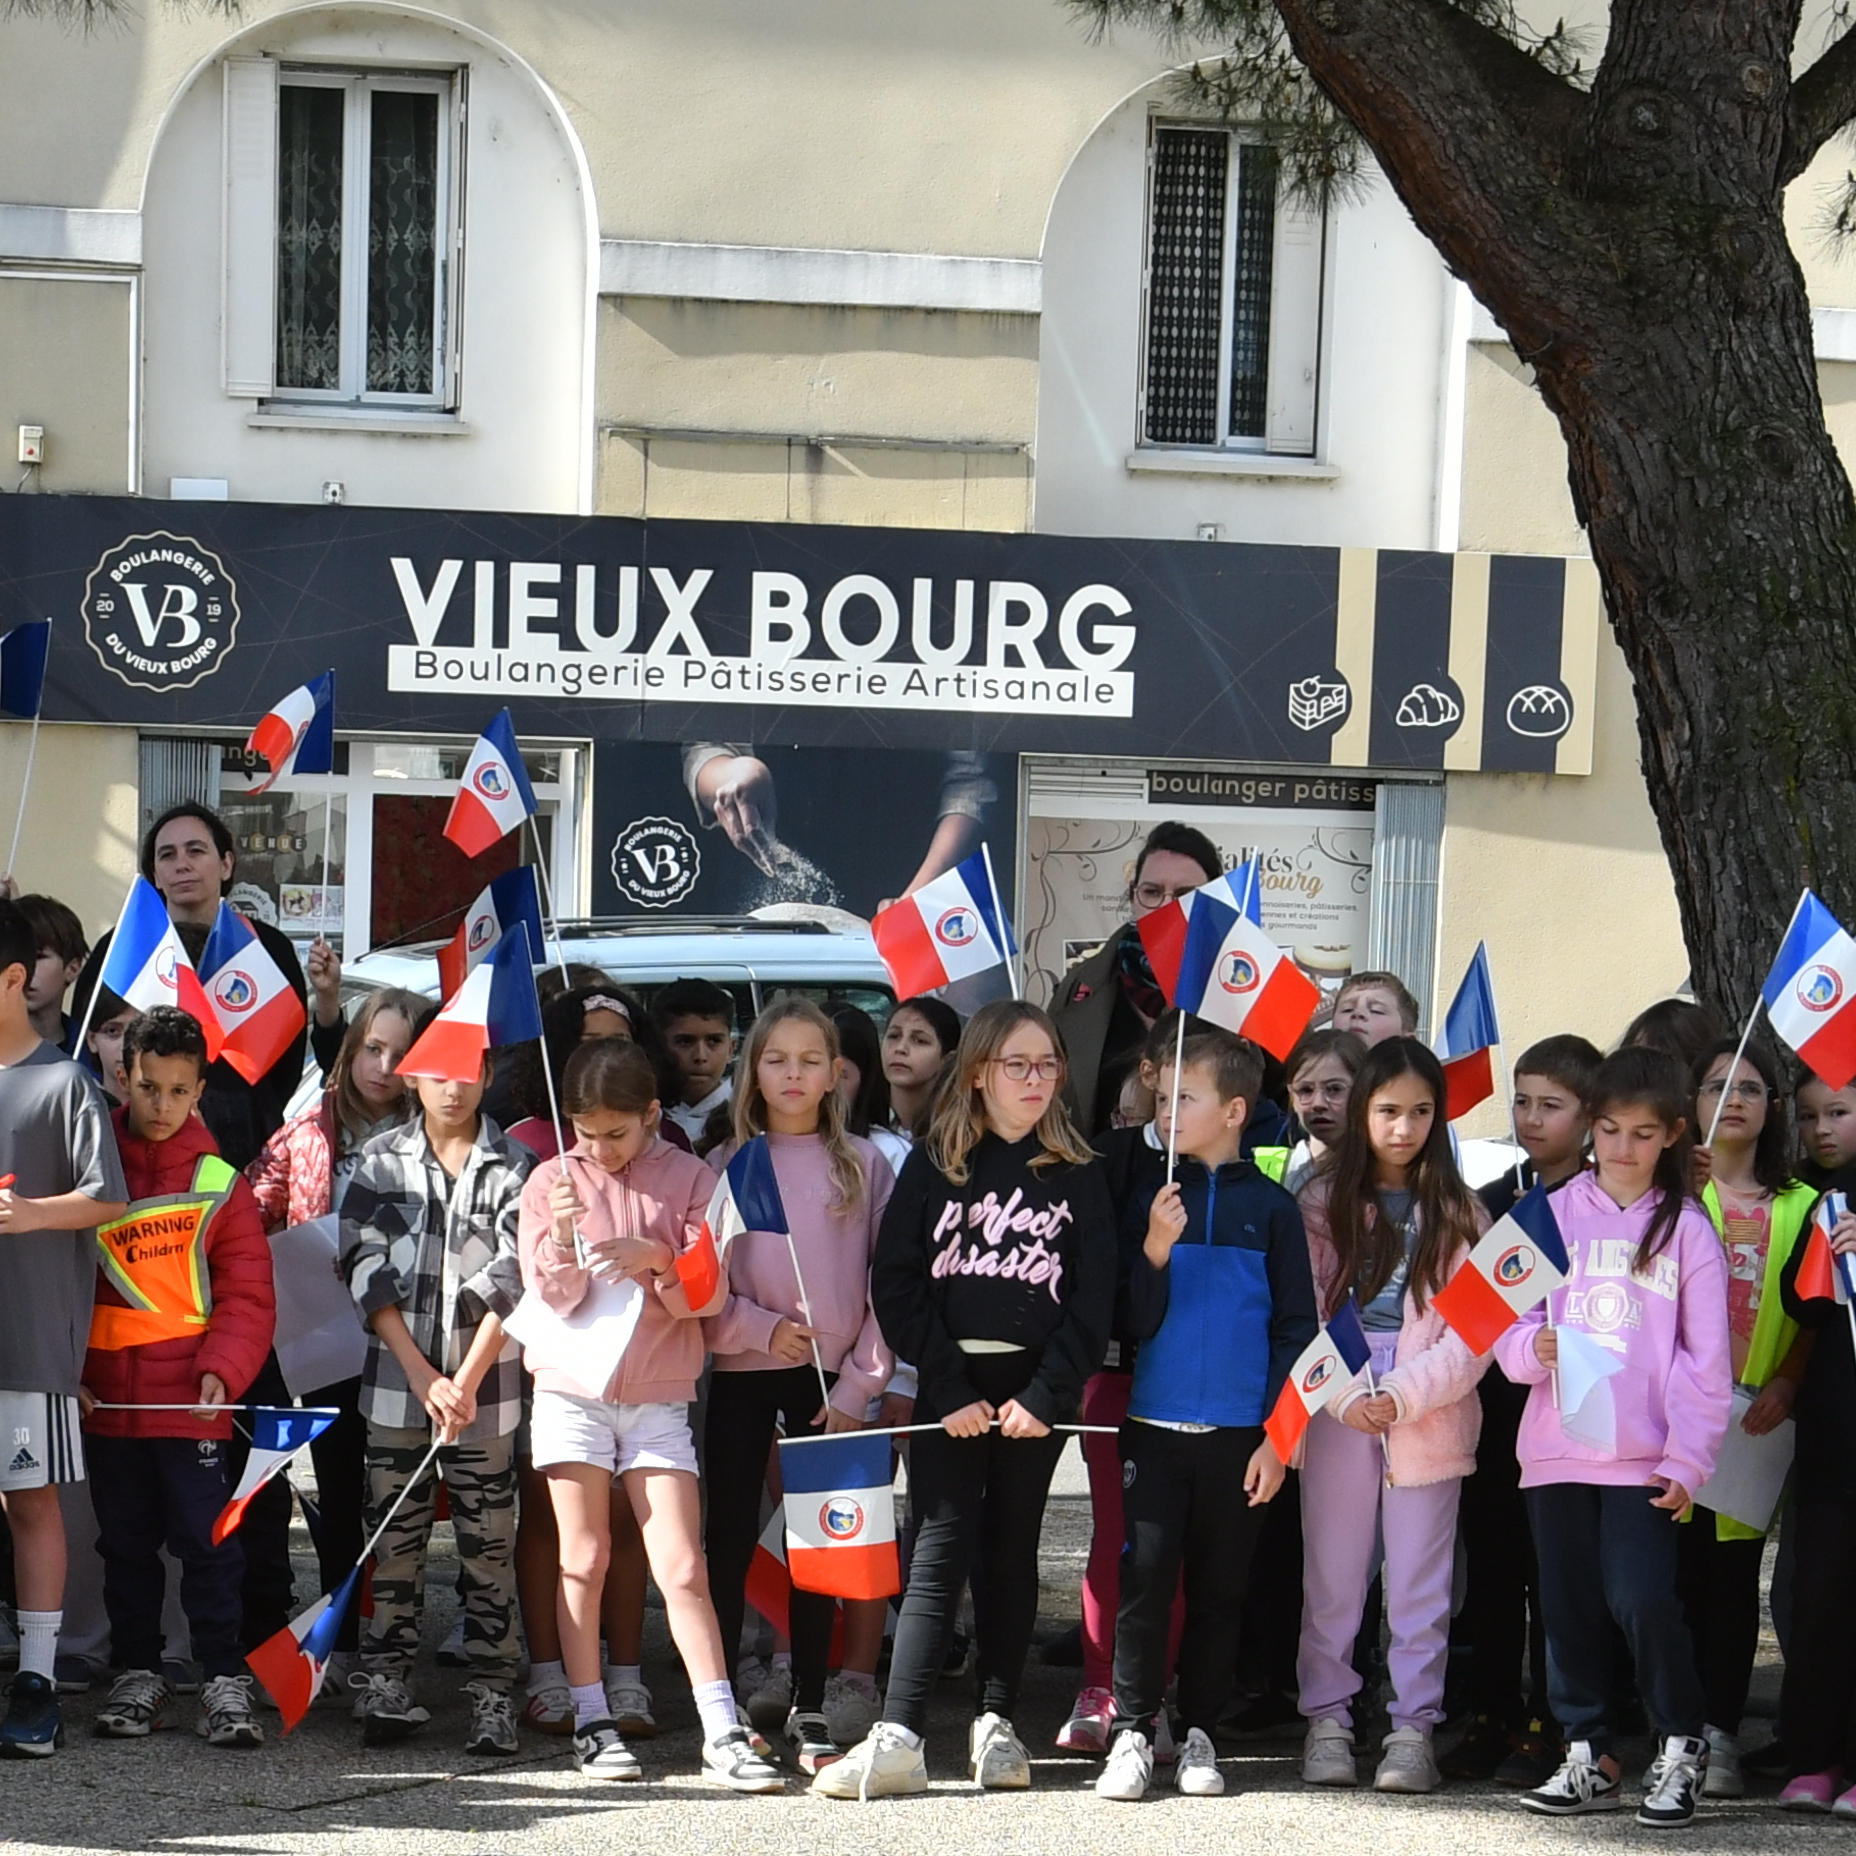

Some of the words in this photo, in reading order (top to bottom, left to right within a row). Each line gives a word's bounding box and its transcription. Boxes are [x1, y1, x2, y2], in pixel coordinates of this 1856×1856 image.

[110, 549, 216, 586] BOULANGERIE
[96, 599, 115, 613] 20
[119, 582, 201, 648] VB
[206, 603, 222, 616] 19
[390, 556, 715, 658] VIEUX
[750, 570, 1138, 673] BOURG
[105, 633, 127, 655] DU
[125, 650, 168, 675] VIEUX
[170, 636, 218, 674] BOURG
[413, 650, 666, 696] Boulangerie
[682, 659, 889, 696] Pâtisserie
[901, 667, 1117, 704] Artisanale
[1151, 771, 1287, 804] boulanger
[1294, 779, 1377, 804] pâtiss
[240, 832, 303, 851] VENUE
[630, 844, 681, 884] VB
[110, 1215, 195, 1247] WARNING
[932, 1186, 1074, 1247] perfect
[125, 1242, 185, 1264] Childrn
[931, 1230, 1064, 1306] disaster
[12, 1426, 30, 1446] 30
[8, 1460, 41, 1472] adidas
